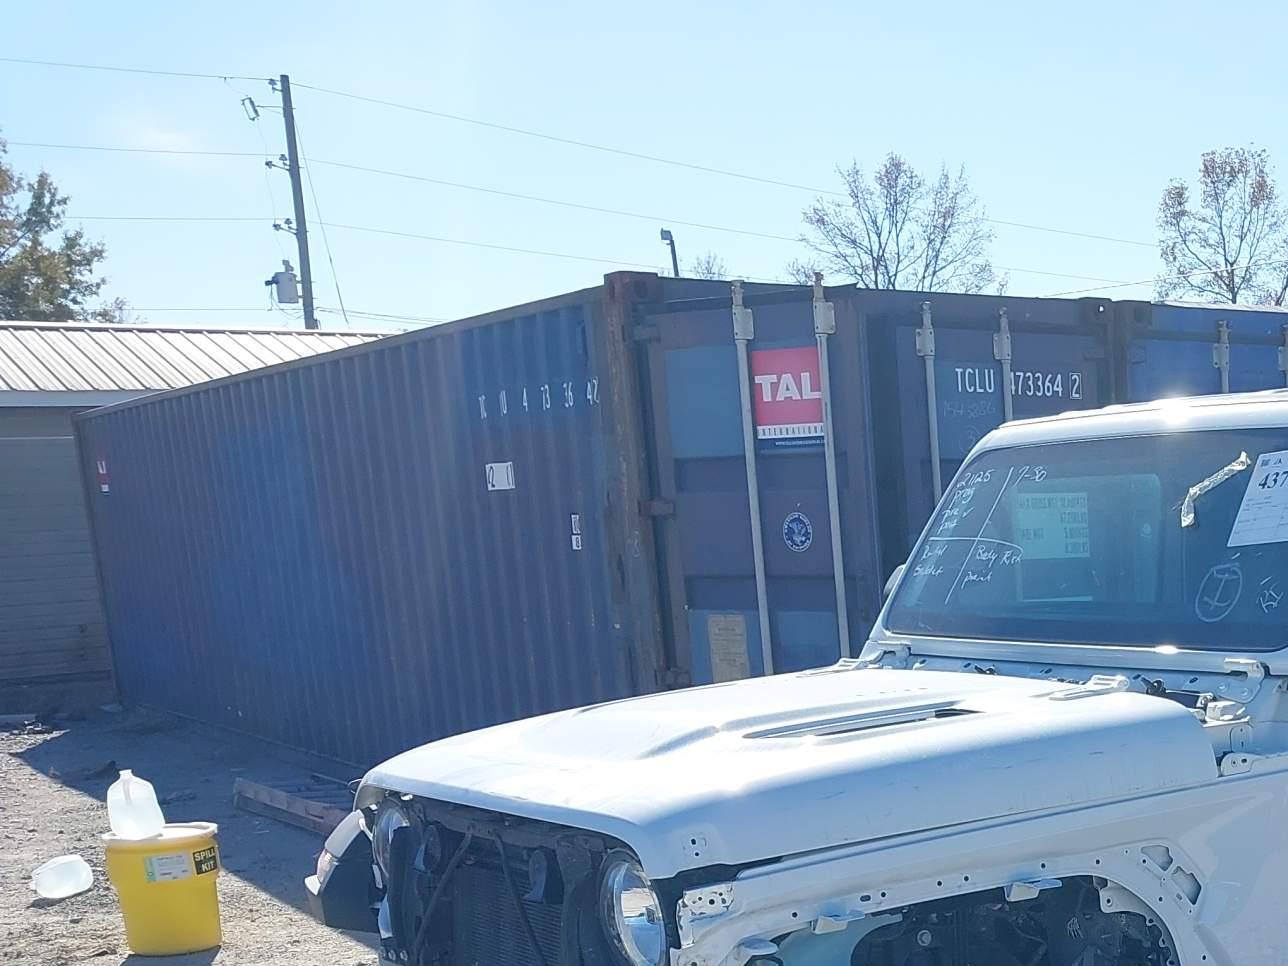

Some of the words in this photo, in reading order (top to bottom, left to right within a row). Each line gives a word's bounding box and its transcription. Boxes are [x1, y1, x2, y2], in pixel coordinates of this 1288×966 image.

[754, 371, 823, 403] TAL
[955, 368, 995, 393] TCLU
[1071, 374, 1081, 398] 2
[194, 848, 215, 861] SPILL
[201, 862, 215, 873] KIT
